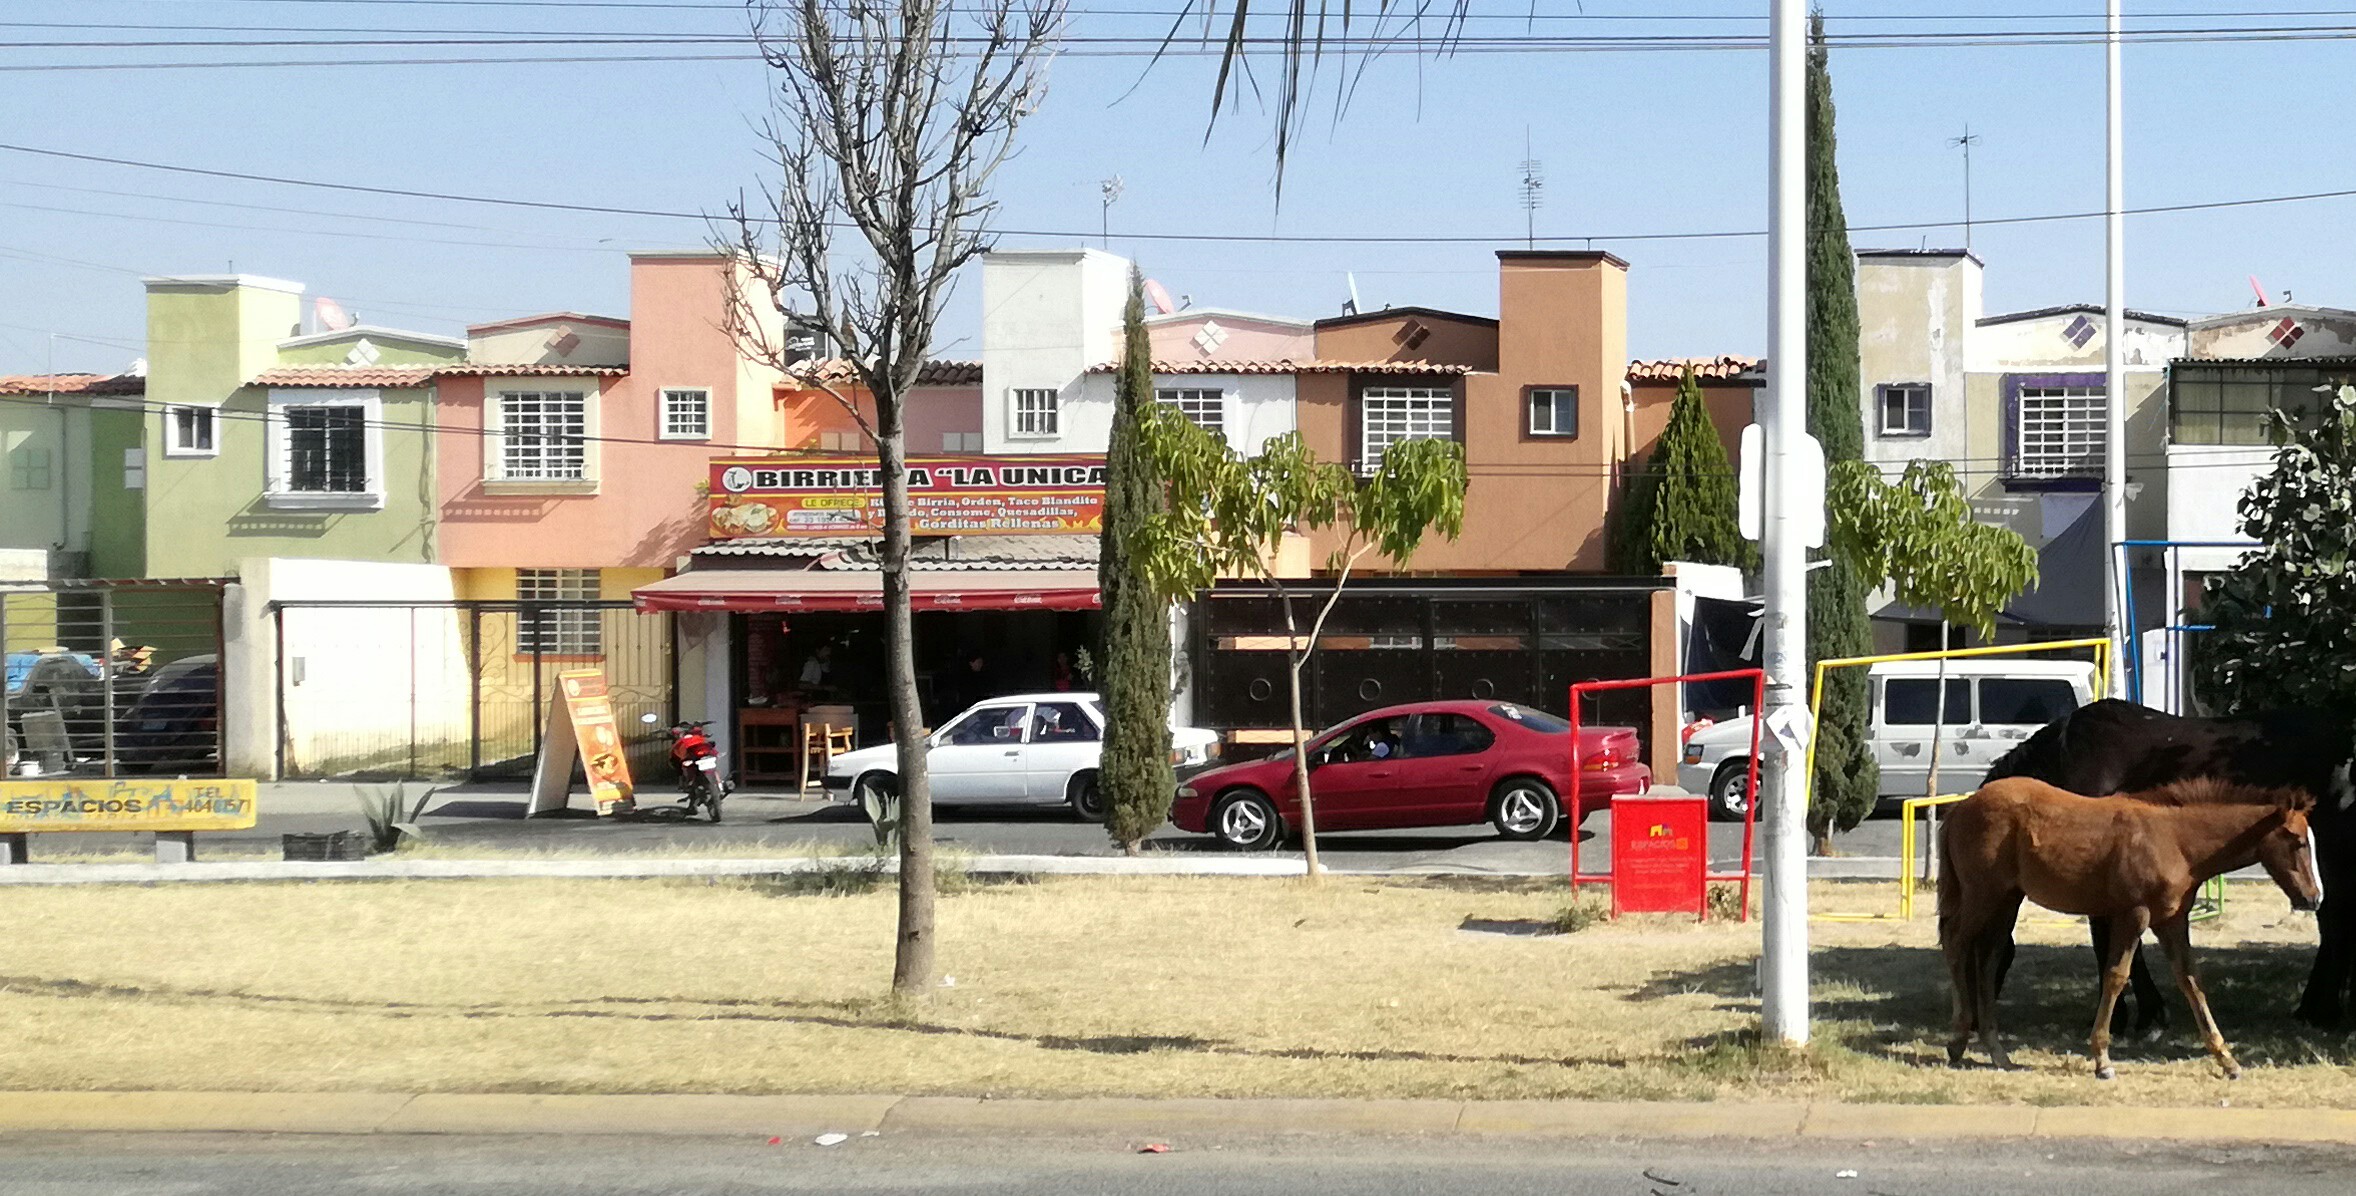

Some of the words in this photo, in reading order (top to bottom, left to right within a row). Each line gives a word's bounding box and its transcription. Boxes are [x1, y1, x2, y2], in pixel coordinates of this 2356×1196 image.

[755, 468, 931, 488] BIRRIEA
[804, 499, 817, 507] LE
[917, 498, 960, 508] Birria,
[961, 497, 1006, 508] Orden,
[1008, 497, 1039, 506] Taco
[1041, 496, 1098, 506] Blandito
[997, 507, 1078, 518] Quesadillas,
[919, 518, 987, 529] Gorditas
[990, 518, 1060, 529] Rellenas
[6, 799, 142, 814] ESPACIOS
